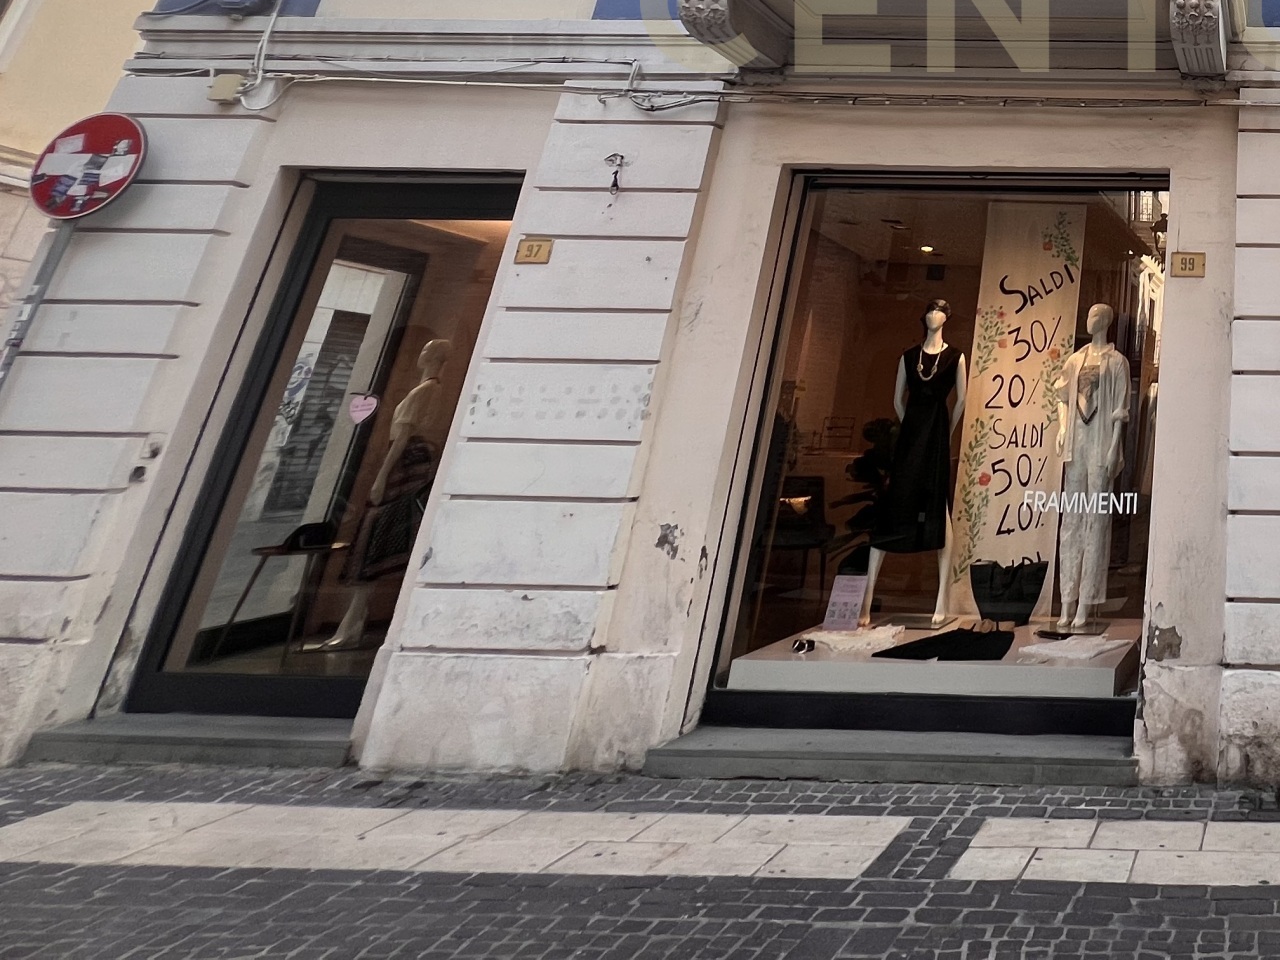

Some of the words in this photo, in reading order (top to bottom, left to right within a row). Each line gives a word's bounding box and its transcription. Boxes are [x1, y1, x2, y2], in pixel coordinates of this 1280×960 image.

[525, 243, 543, 258] 97
[1180, 257, 1195, 271] 99
[999, 263, 1075, 315] SALDI
[1007, 315, 1062, 362] 30%
[985, 373, 1041, 409] 20%
[988, 418, 1044, 450] SALDI
[991, 453, 1048, 496] 50%
[1022, 490, 1138, 514] FRAMMENTI
